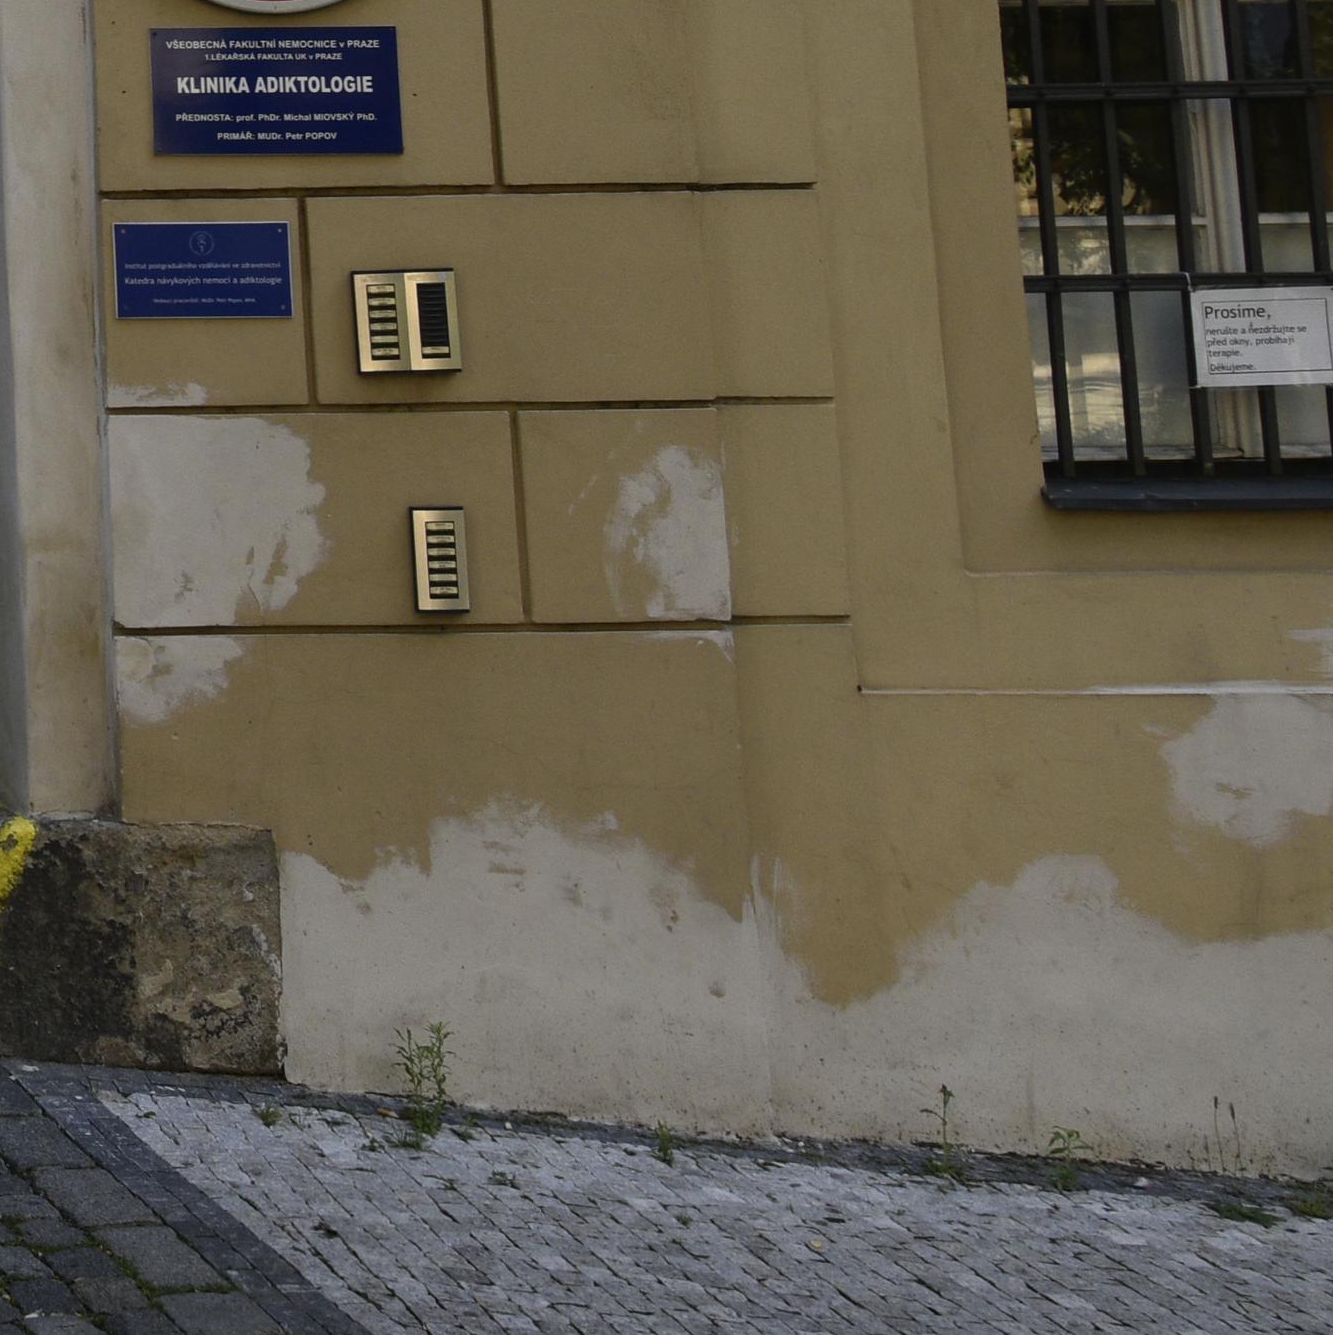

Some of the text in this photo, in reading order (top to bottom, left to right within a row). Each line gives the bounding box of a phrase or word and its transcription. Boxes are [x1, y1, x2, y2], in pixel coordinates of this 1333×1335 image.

[166, 39, 227, 49] VŠEOBECNÁ
[229, 39, 277, 49] FAKULTNÍ
[278, 40, 337, 48] NEMOCNICE
[347, 40, 380, 48] PRAZE
[176, 76, 373, 94] KLINIKA ADIKTOLOGIE
[176, 112, 233, 122] PŘEDNOSTA:
[258, 113, 282, 122] PhDr.
[284, 113, 312, 121] Michal
[314, 112, 355, 121] MIOVSKÝ
[357, 113, 378, 121] PhD.
[217, 131, 337, 140] PRIMÁŘ: MUDr. Petr POPOV
[124, 277, 155, 285] Katedra
[157, 276, 201, 286] návykových
[239, 276, 282, 286] adiktologie
[1204, 304, 1271, 320] Prosíme,
[1206, 325, 1238, 335] nerušte
[1207, 338, 1227, 348] před
[1210, 363, 1257, 373] Děkujeme.
